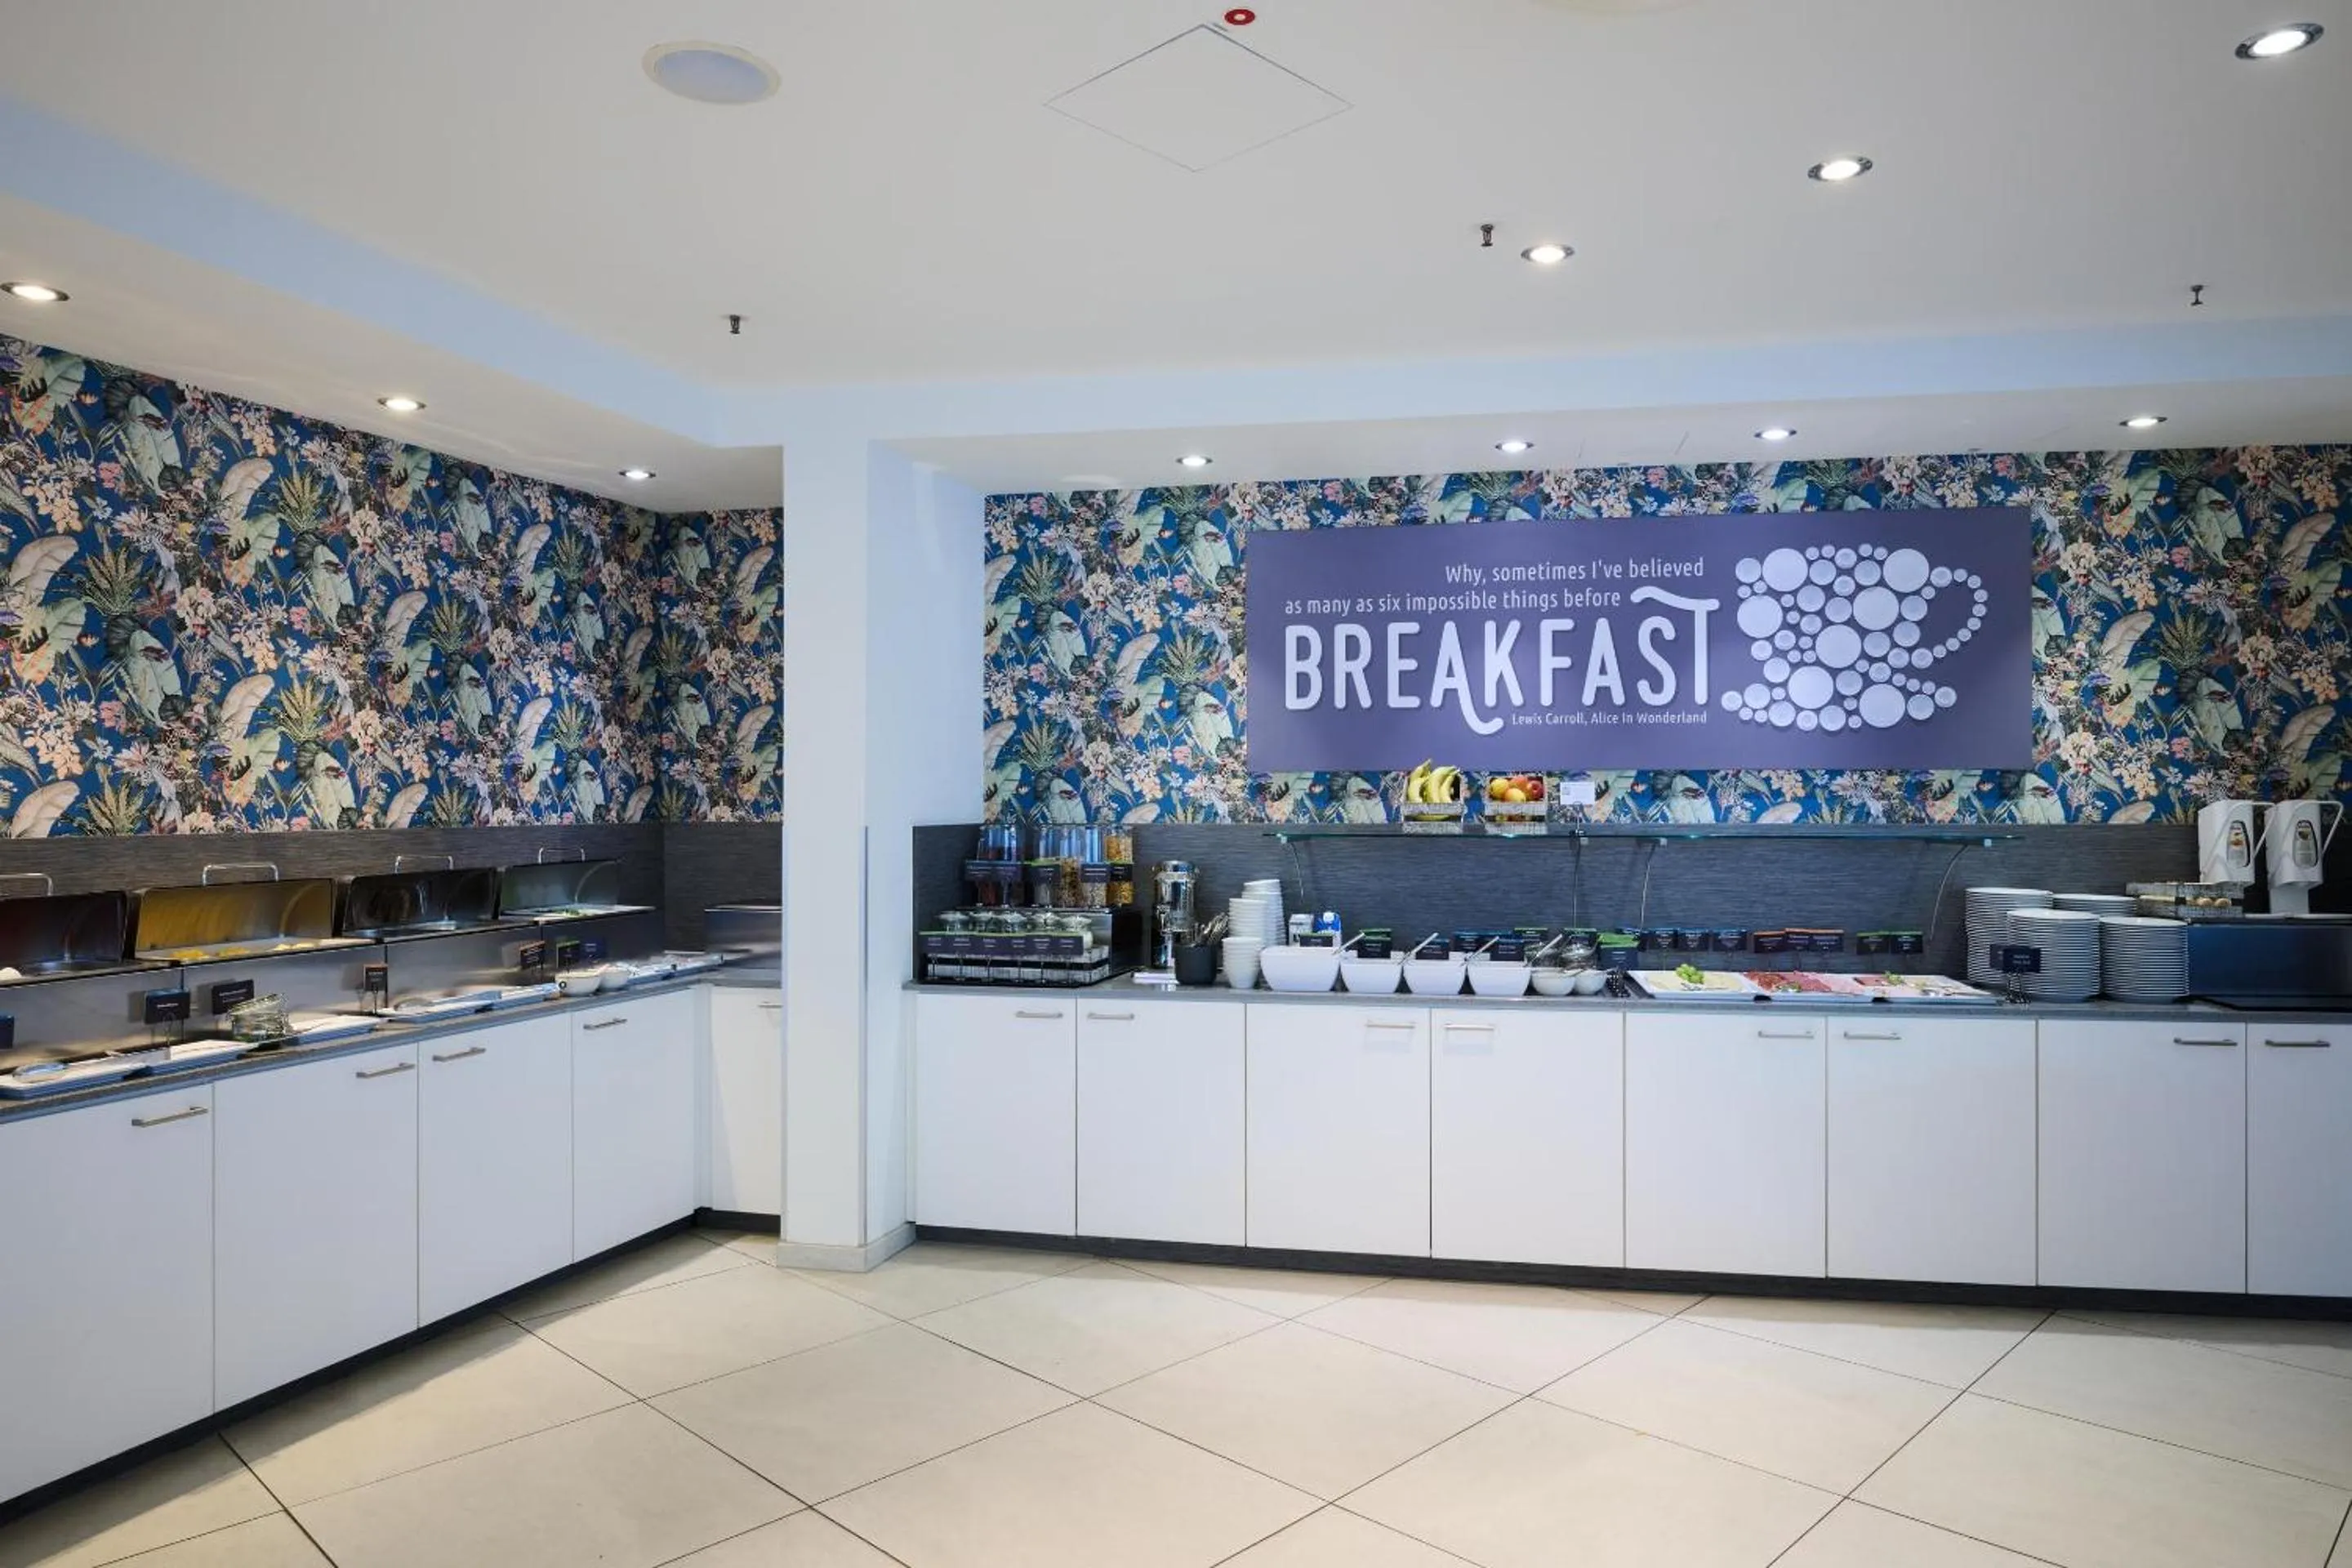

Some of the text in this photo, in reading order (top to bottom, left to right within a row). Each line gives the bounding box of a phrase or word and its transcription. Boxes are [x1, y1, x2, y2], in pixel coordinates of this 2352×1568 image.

[1445, 557, 1704, 586] Why, sometimes I've believed
[1285, 587, 1621, 617] as many as six impossible things before
[1285, 586, 1721, 736] BREAKFAST
[1512, 713, 1543, 726] Lewis
[1546, 711, 1588, 727] Carroll,
[1591, 711, 1619, 725] Alice
[1637, 710, 1708, 724] Wonderland
